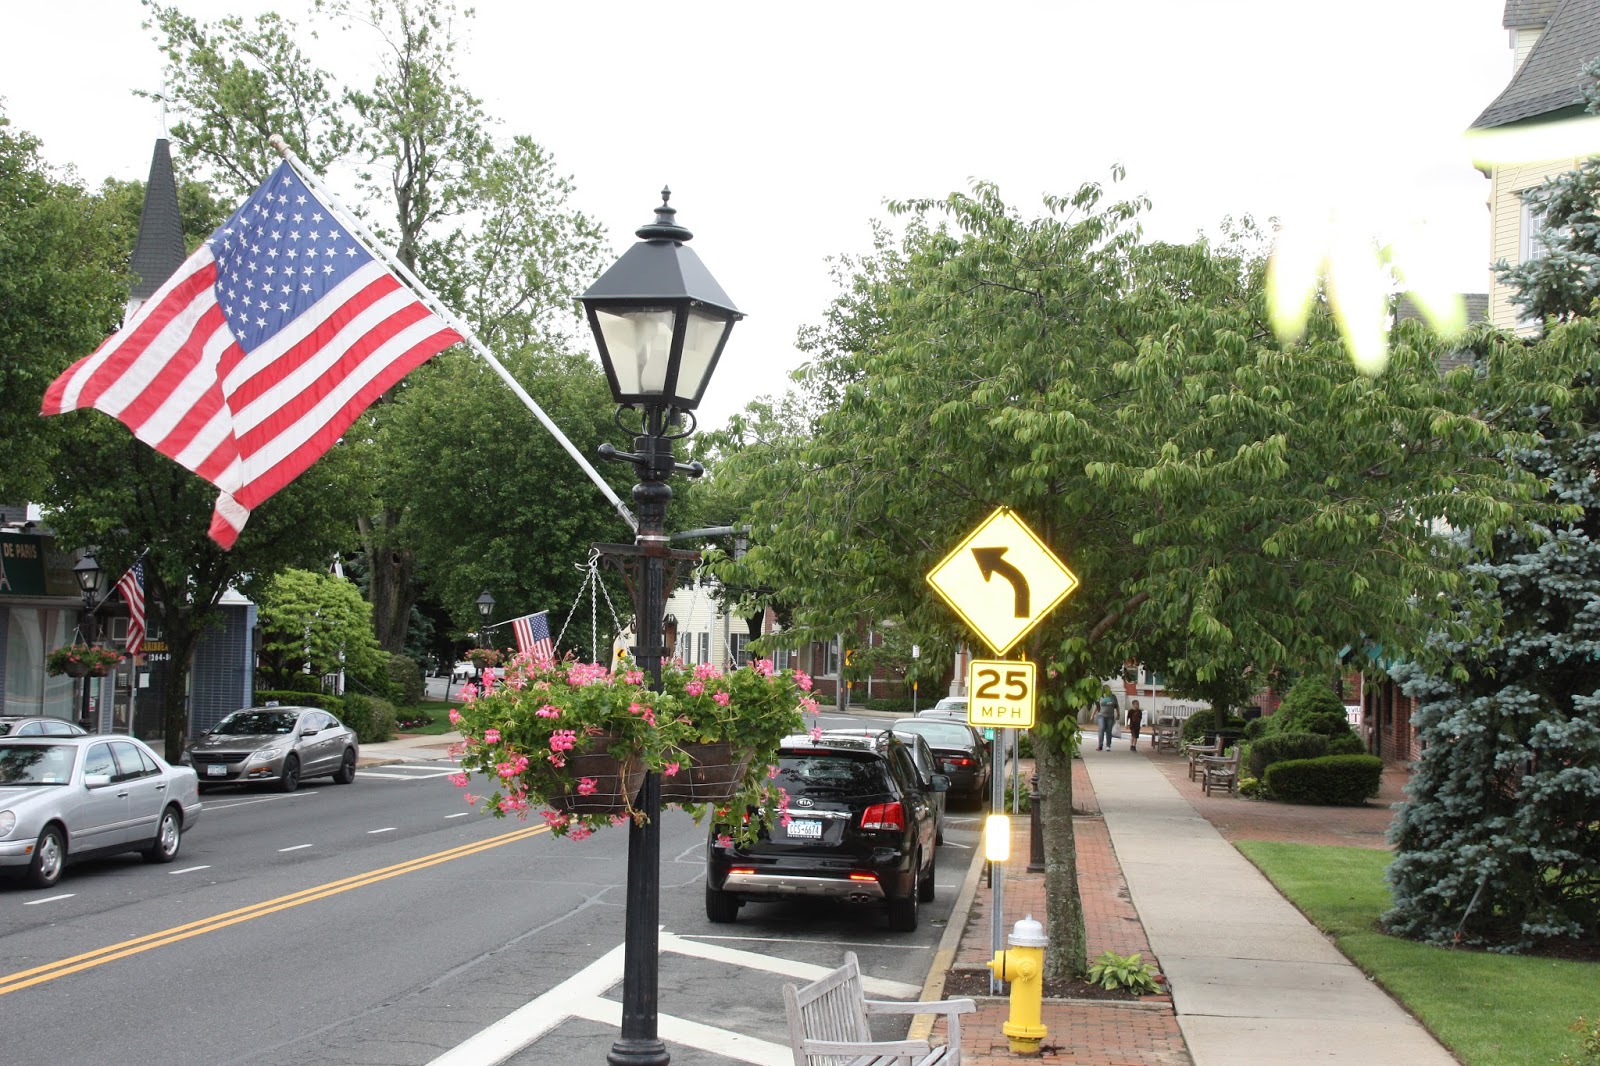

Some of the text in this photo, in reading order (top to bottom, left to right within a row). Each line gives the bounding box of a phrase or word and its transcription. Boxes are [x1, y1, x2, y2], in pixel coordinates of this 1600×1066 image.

[3, 543, 37, 558] DE PARIS
[976, 669, 1028, 701] 25
[982, 706, 1021, 718] MPH
